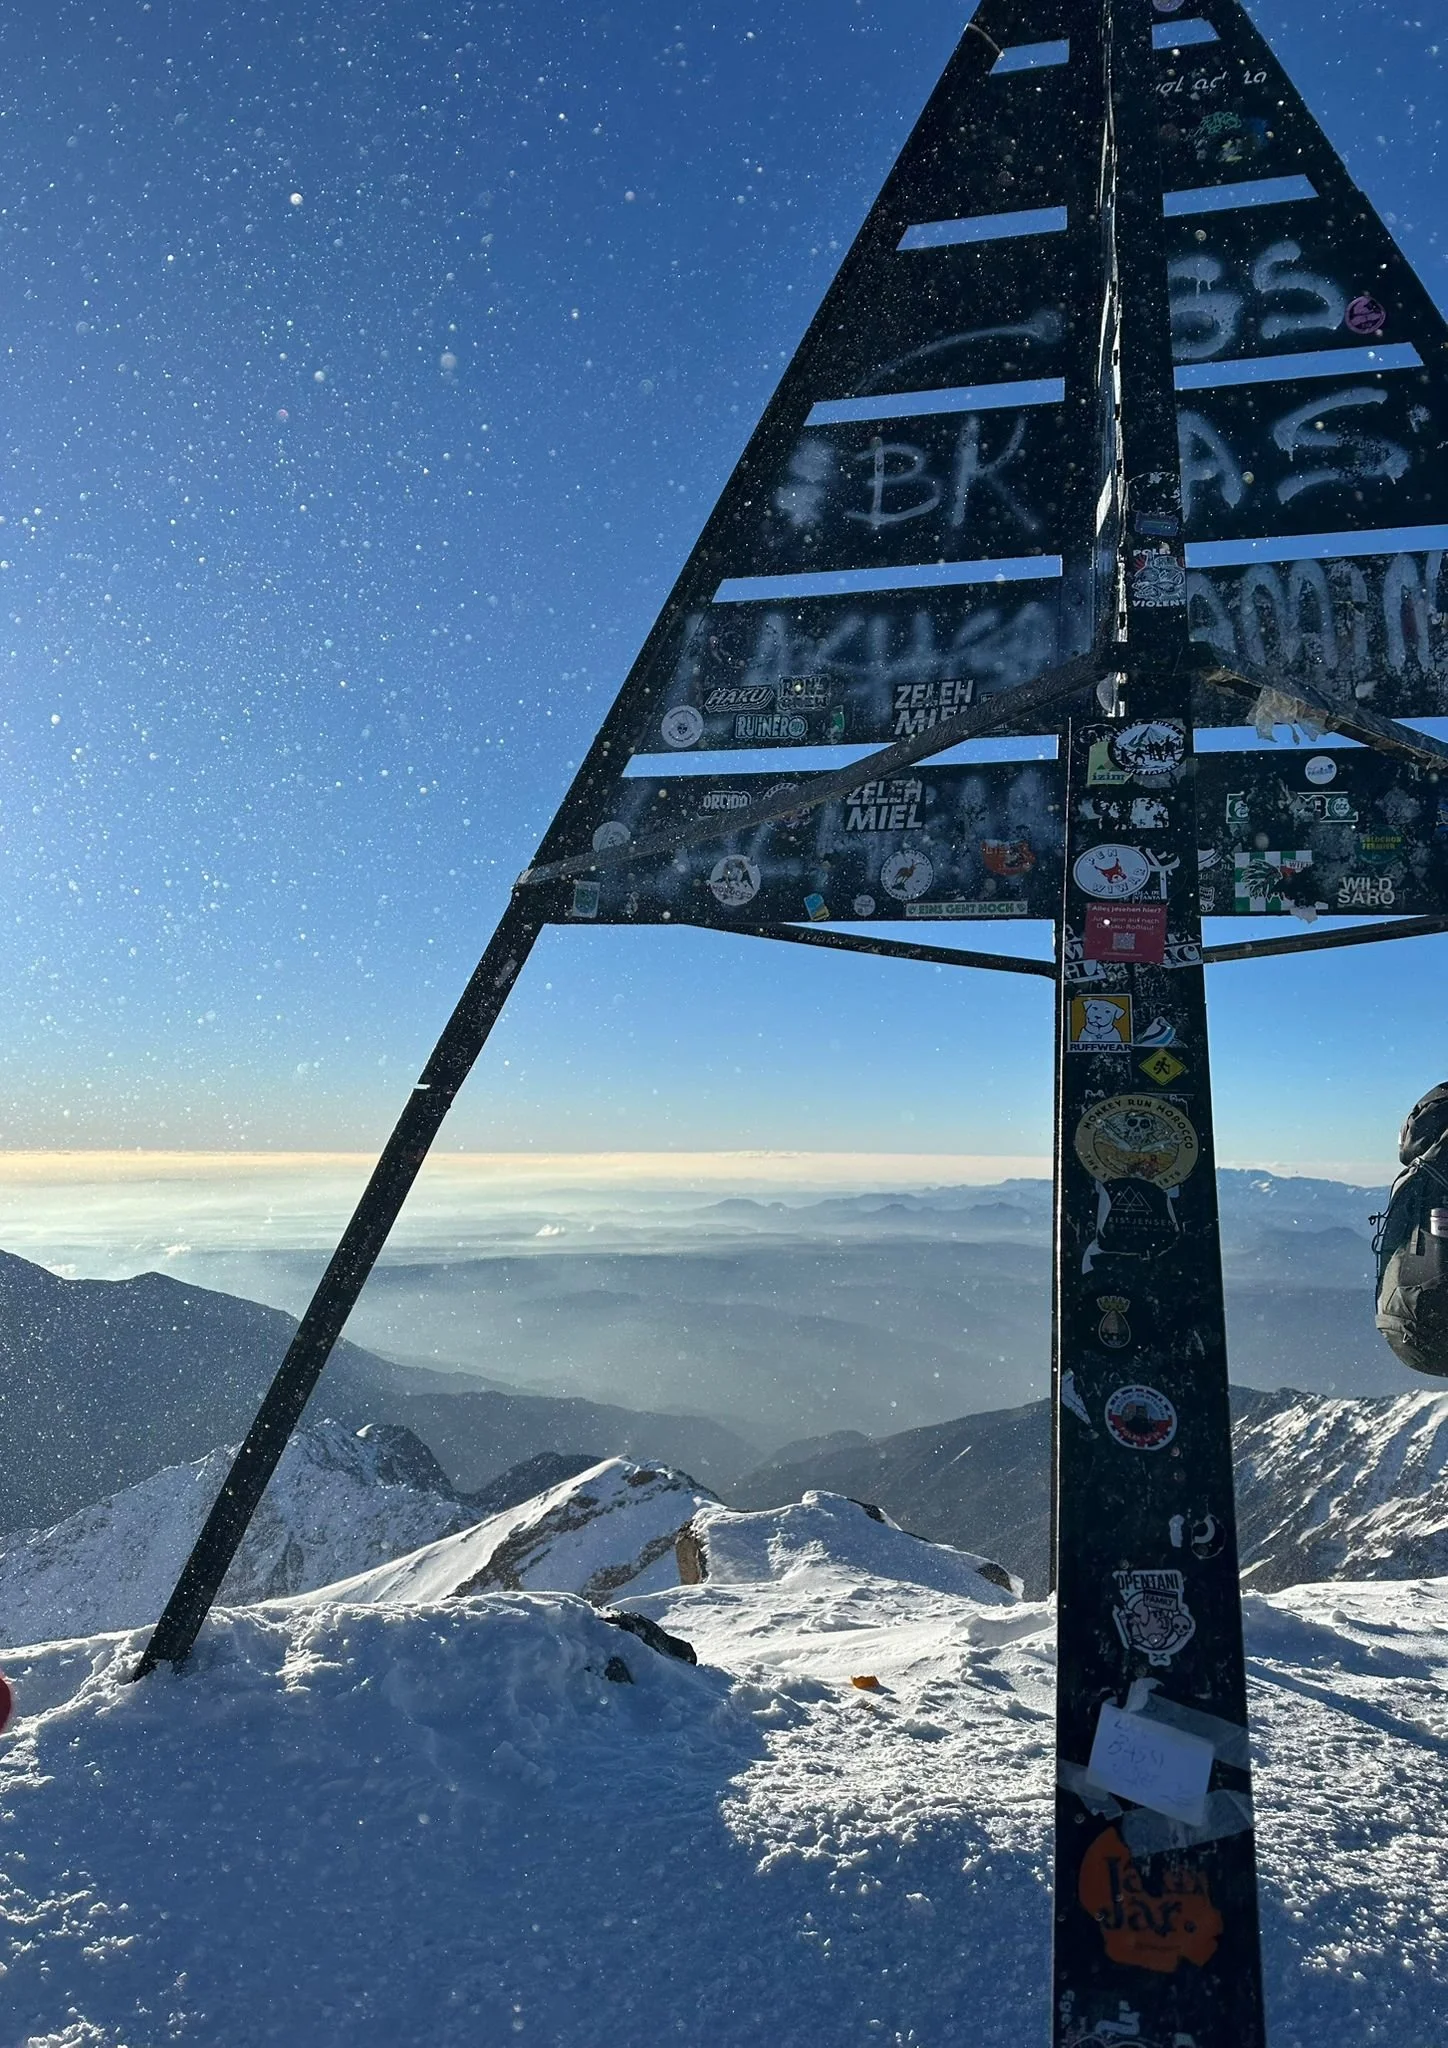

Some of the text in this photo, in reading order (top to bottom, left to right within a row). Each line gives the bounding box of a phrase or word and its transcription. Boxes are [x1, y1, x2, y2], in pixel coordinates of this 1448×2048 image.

[1131, 598, 1187, 608] VIOLENT
[846, 802, 924, 831] MIEL
[1091, 905, 1110, 913] Alles
[1070, 1043, 1133, 1052] RUFFWEAR
[1083, 1098, 1194, 1150] MONKEY RUN MOROCCO
